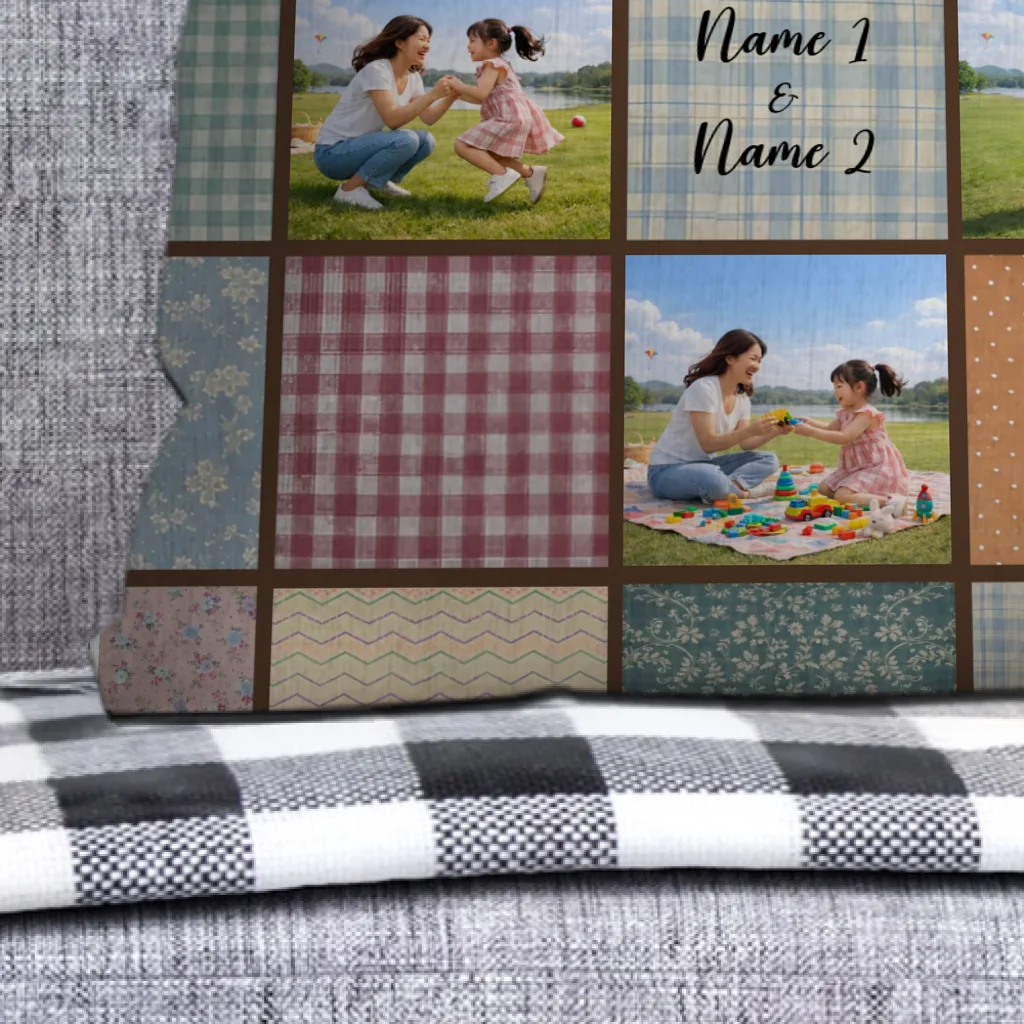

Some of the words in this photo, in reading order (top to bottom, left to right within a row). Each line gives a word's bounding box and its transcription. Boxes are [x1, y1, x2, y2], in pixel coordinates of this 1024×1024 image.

[696, 5, 832, 64] Name
[848, 17, 871, 64] 1
[767, 81, 799, 113] &
[693, 117, 830, 176] Name
[844, 128, 875, 175] 2
